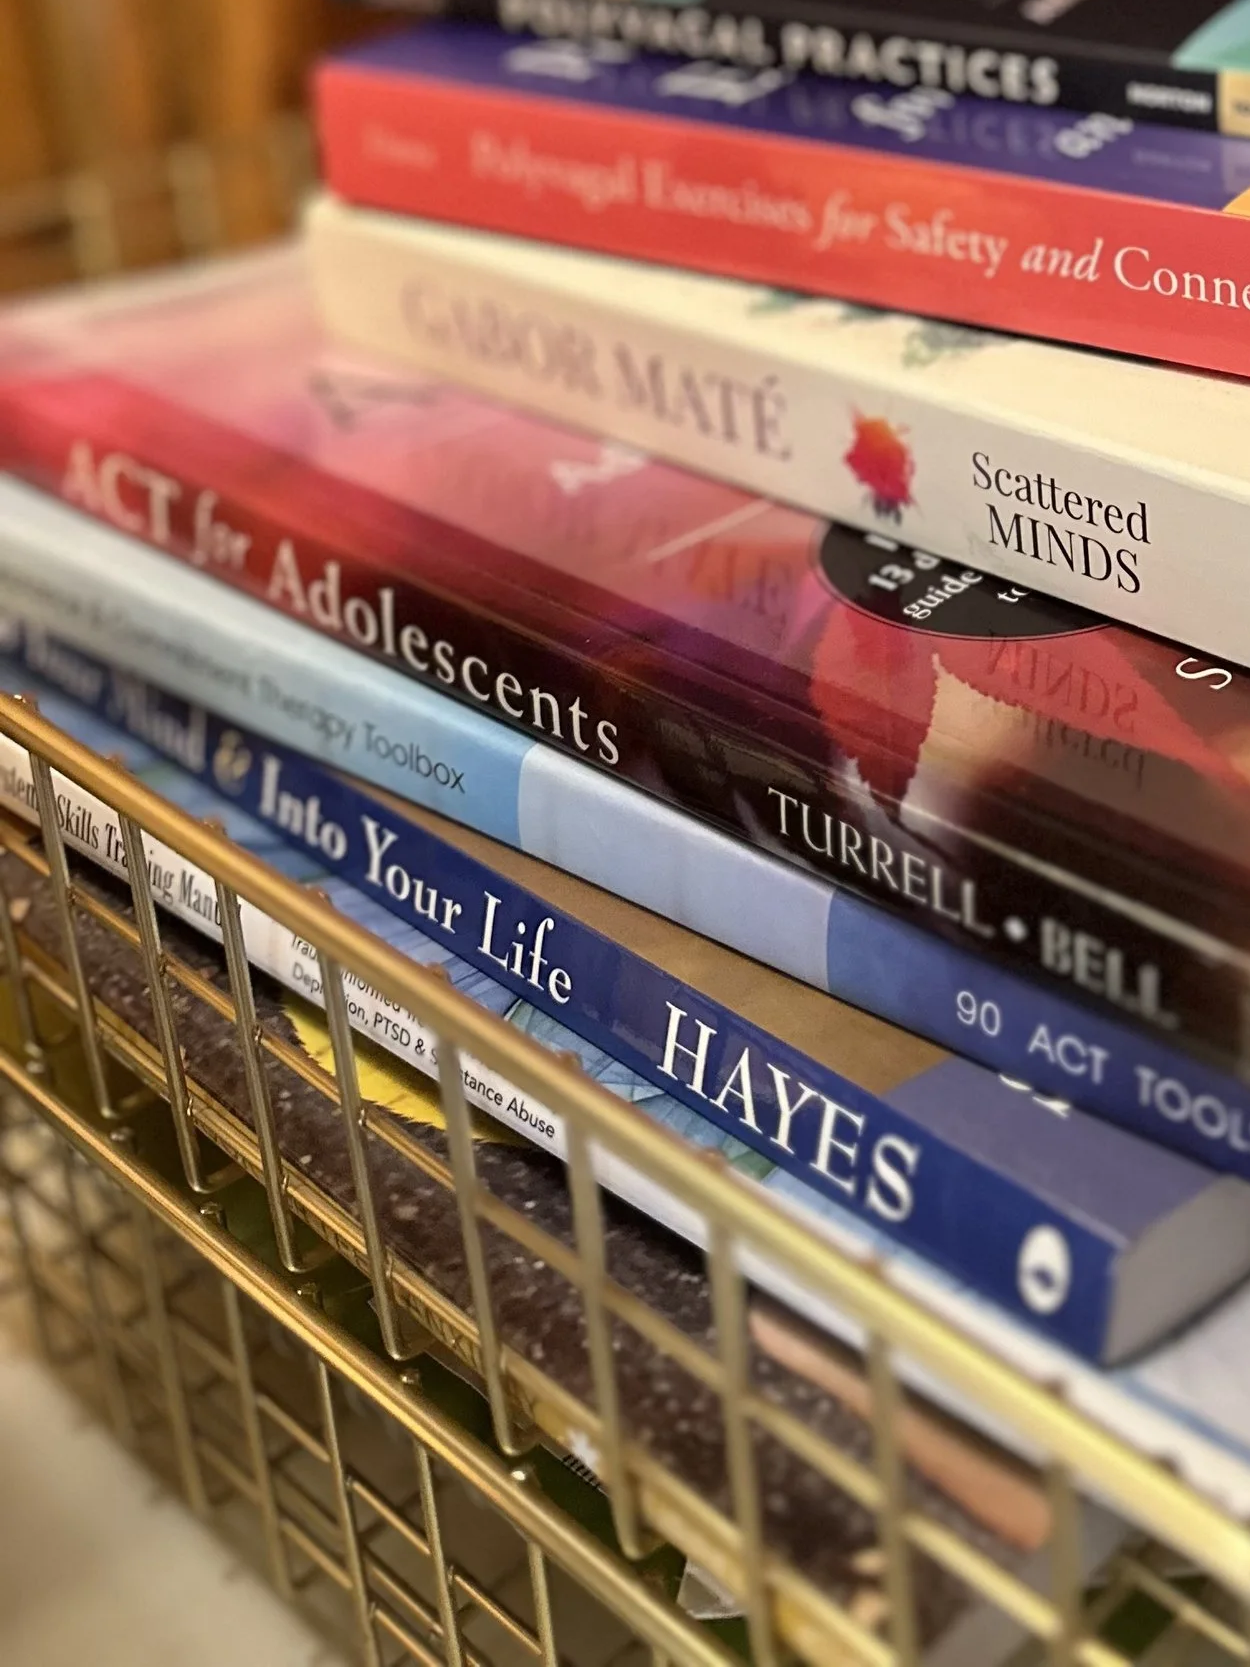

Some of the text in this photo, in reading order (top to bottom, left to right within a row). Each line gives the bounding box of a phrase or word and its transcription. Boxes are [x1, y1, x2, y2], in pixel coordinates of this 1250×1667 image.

[781, 21, 1059, 104] PRACTICES
[886, 203, 1007, 278] Safety
[1020, 238, 1103, 282] and
[612, 341, 794, 462] MATÉ
[972, 451, 1151, 544] Scattered
[985, 503, 1140, 594] MINDS
[60, 438, 182, 544] ACT
[266, 537, 620, 767] Adolescents
[254, 672, 357, 752] Therapy
[362, 720, 467, 794] Toolbox
[57, 793, 99, 850] Skills
[767, 787, 1180, 1031] TURRELL BELL
[259, 752, 348, 861] Into
[361, 814, 463, 934] Your
[477, 889, 572, 1004] Life
[656, 1001, 922, 1223] HAYES
[956, 989, 1001, 1036] 90
[1028, 1023, 1111, 1085] ACT
[373, 1013, 411, 1047] PTSD
[414, 1038, 426, 1056] &
[506, 1096, 556, 1139] Abuse
